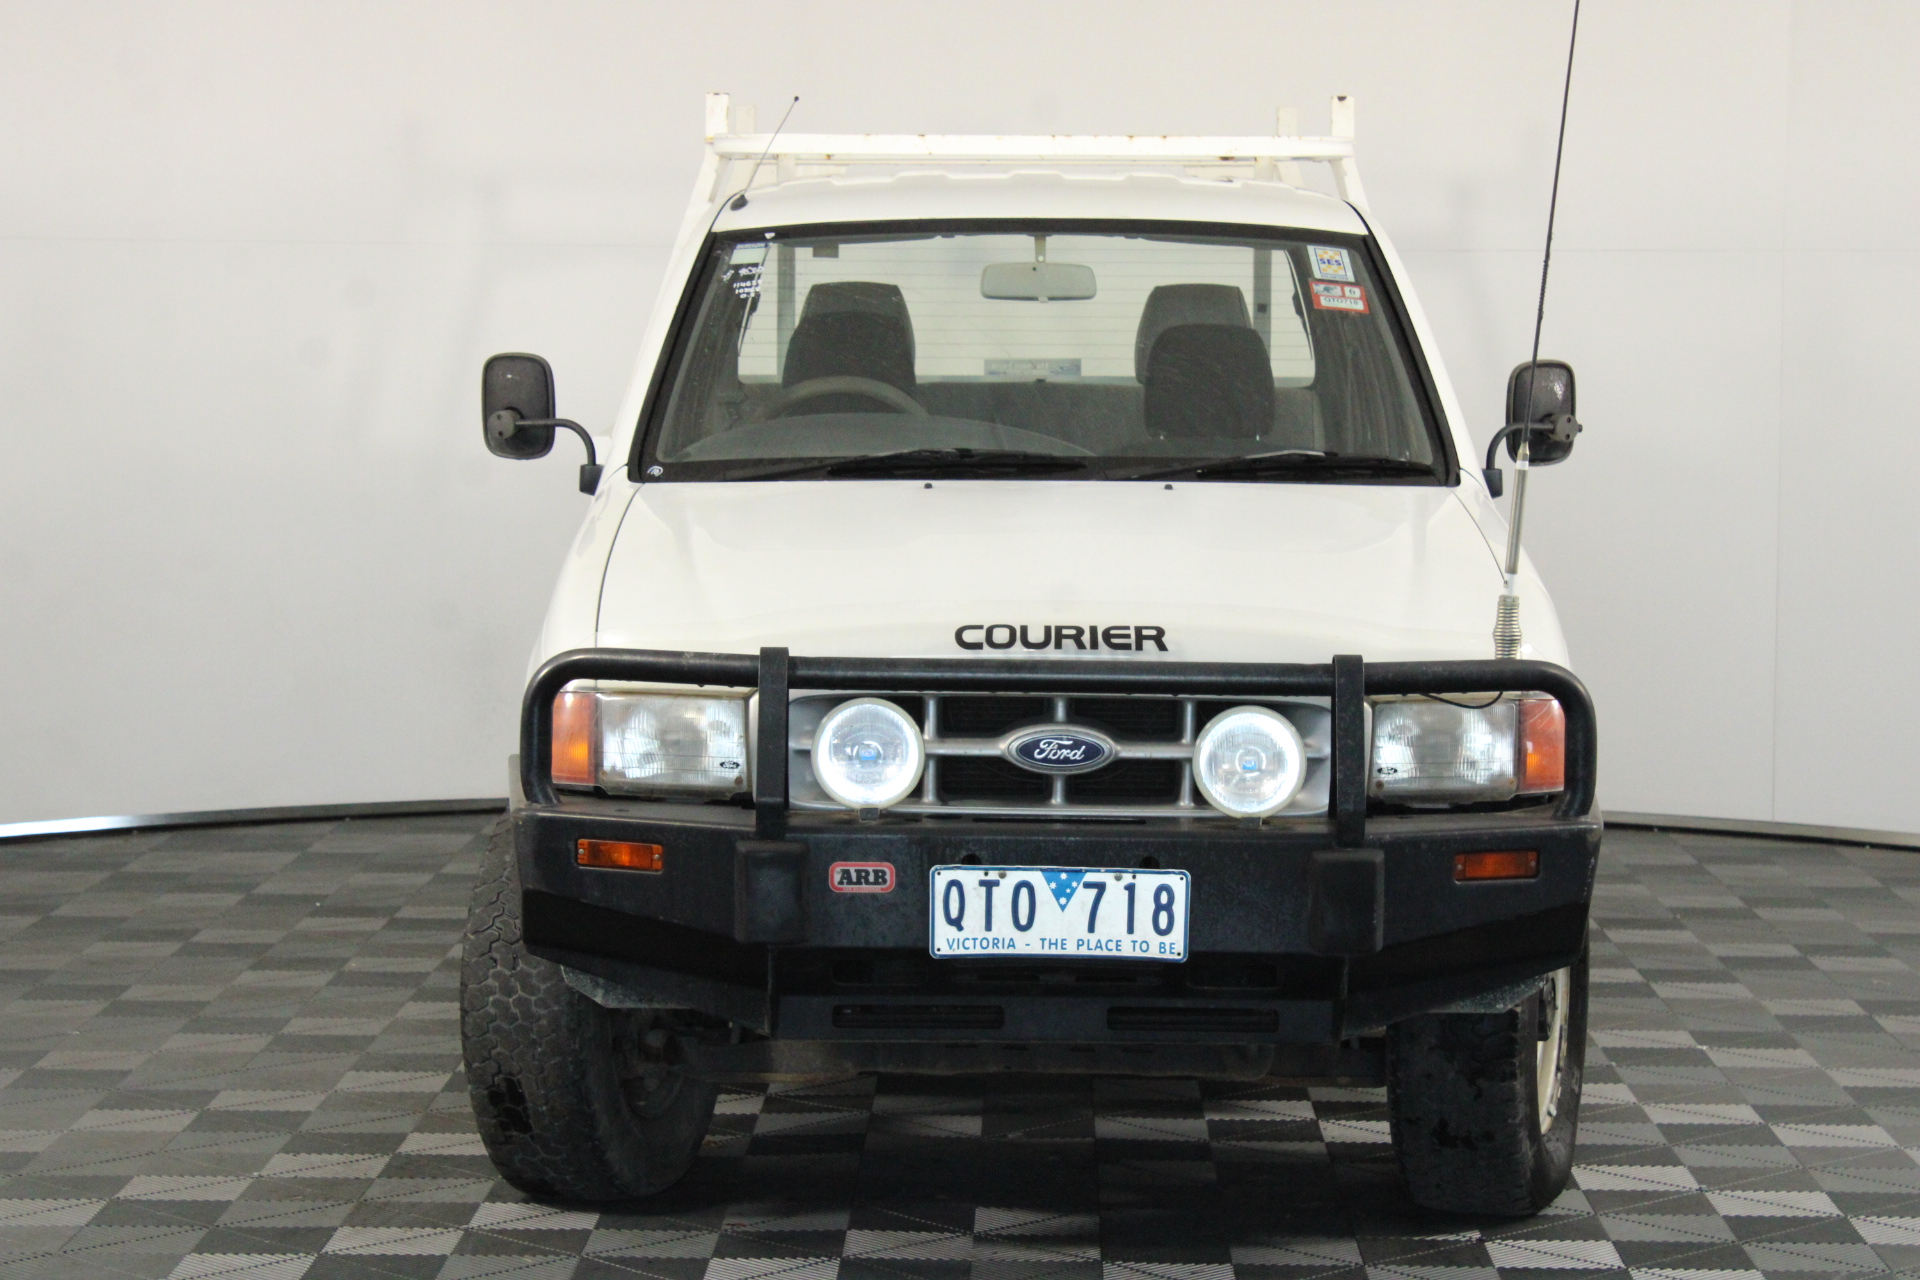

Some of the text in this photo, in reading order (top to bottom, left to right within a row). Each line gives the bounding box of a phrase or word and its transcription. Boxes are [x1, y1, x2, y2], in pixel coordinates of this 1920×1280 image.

[955, 624, 1169, 652] COURIER
[1034, 739, 1086, 760] Ford
[837, 868, 888, 886] ARB
[946, 937, 1017, 951] VICTORIA
[1039, 937, 1068, 951] THE
[1076, 938, 1123, 952] PLACE
[1132, 940, 1150, 954] TO
[1158, 941, 1177, 955] BE
